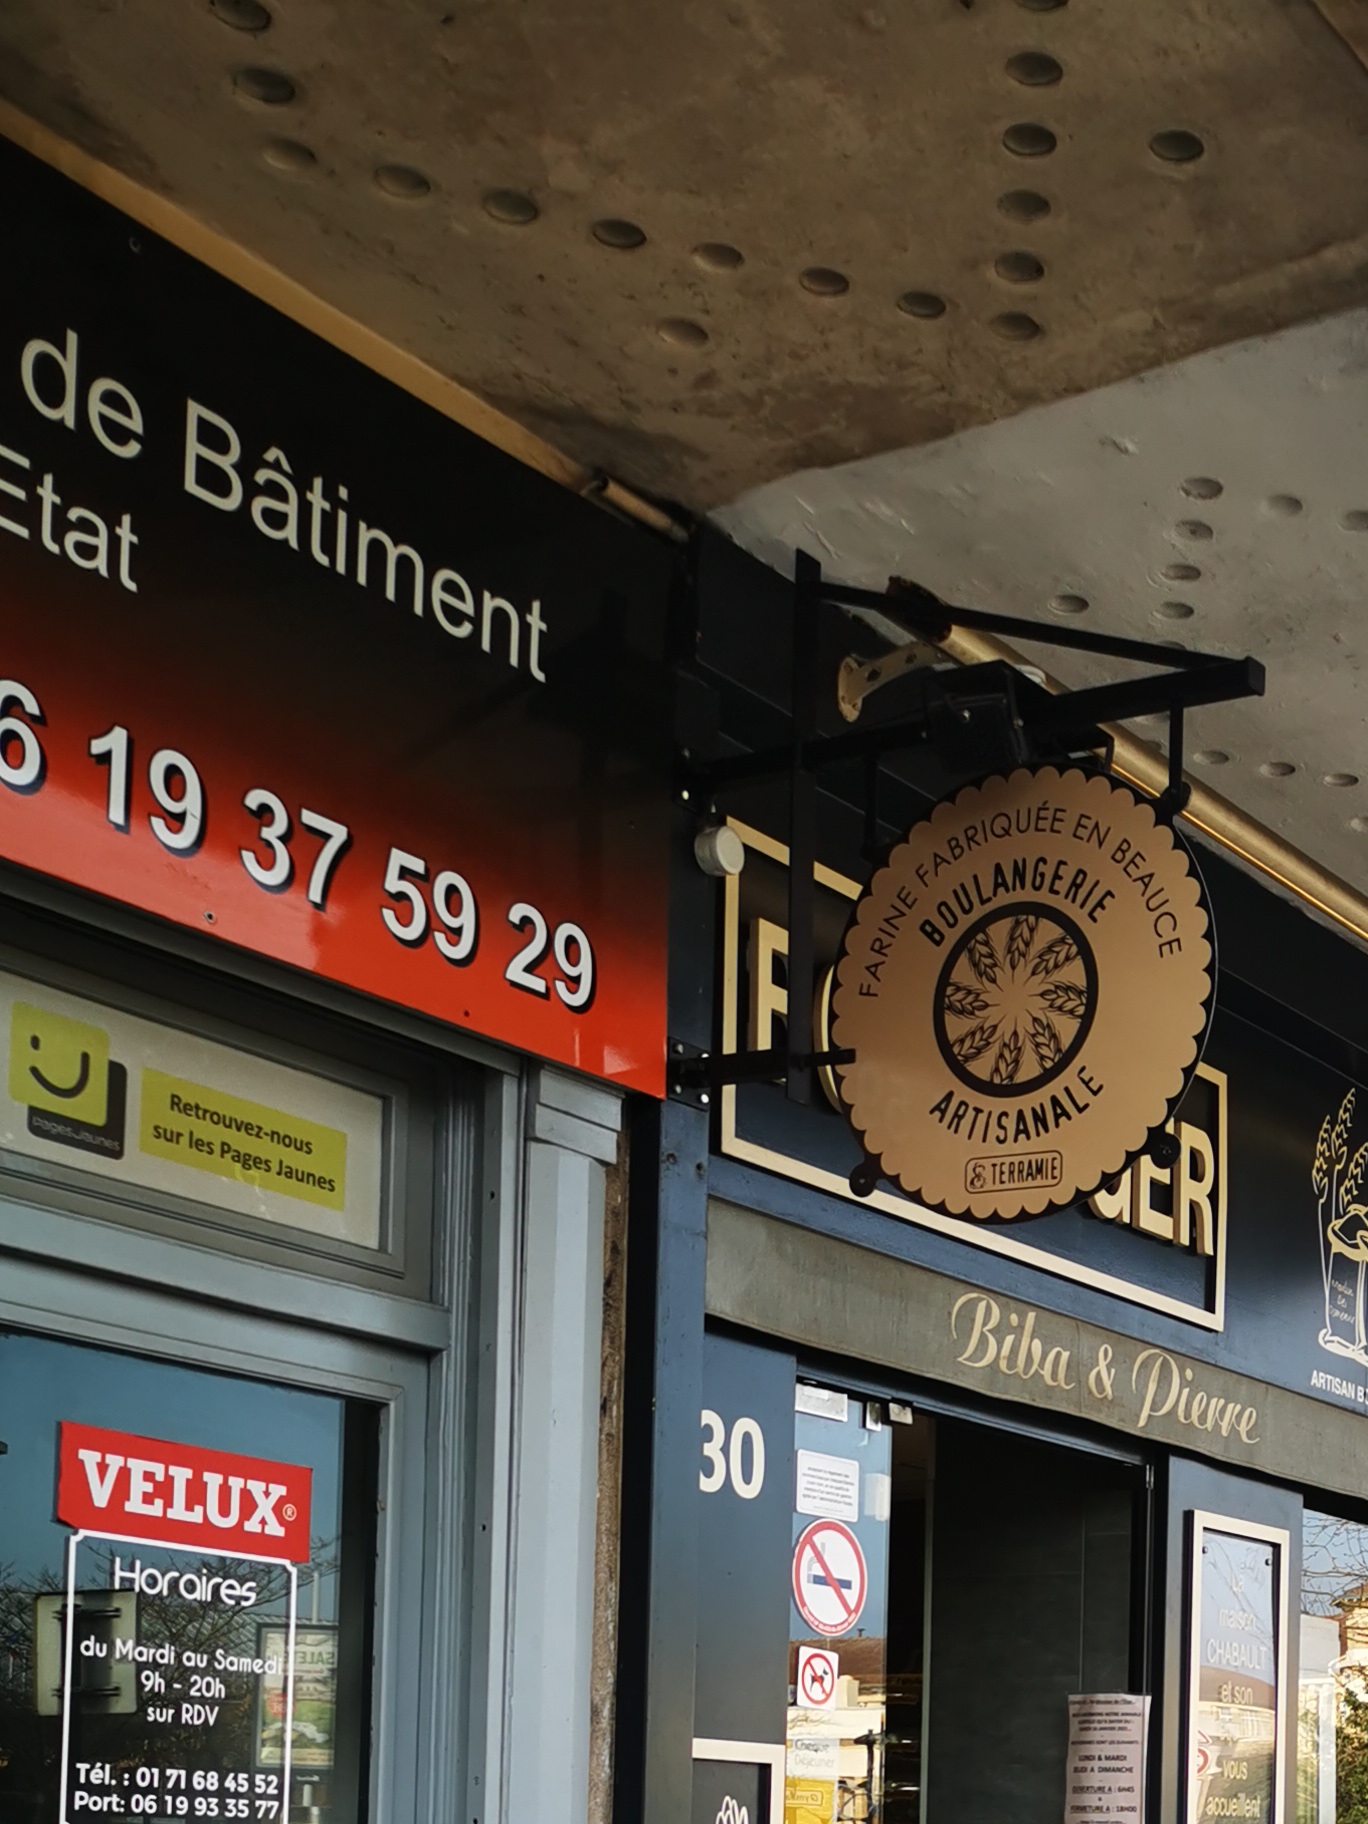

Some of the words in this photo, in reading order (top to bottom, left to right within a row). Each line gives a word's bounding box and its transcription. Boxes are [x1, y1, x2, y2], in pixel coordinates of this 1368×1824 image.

[21, 327, 145, 459] de
[183, 396, 548, 682] Bâtiment
[89, 725, 204, 855] 19
[240, 788, 348, 909] 37
[381, 848, 477, 966] 59
[506, 902, 595, 1011] 29
[859, 885, 919, 998] FARINE
[915, 799, 1068, 890] FABRIQUÉE
[1073, 812, 1112, 850] EN
[1110, 837, 1184, 961] BEAUCE
[918, 856, 1118, 948] BOULANGERIE
[169, 1092, 313, 1155] Retrouvez-nous
[928, 1064, 1105, 1145] ARTISANALE
[152, 1124, 183, 1146] sur
[188, 1127, 214, 1155] les
[220, 1141, 272, 1172] Pages
[276, 1159, 337, 1193] Jaunes
[990, 1154, 1059, 1187] TERRAMIE
[950, 1291, 1076, 1391] Biba
[1087, 1343, 1116, 1401] &
[1131, 1348, 1261, 1445] Pierre
[1310, 1370, 1355, 1399] ARTISAN
[699, 1409, 766, 1501] 30
[77, 1449, 288, 1538] VELUX
[112, 1555, 258, 1607] Horaires
[1220, 1605, 1256, 1631] maison
[80, 1635, 107, 1658] du
[115, 1638, 175, 1666] Mardi
[182, 1651, 207, 1668] au
[214, 1649, 283, 1675] Samedi
[1207, 1639, 1267, 1670] CHABAULT
[141, 1671, 165, 1694] 9h
[189, 1676, 225, 1699] 20h
[1221, 1680, 1232, 1702] et
[1234, 1686, 1253, 1705] son
[146, 1706, 175, 1723] sur
[181, 1704, 219, 1727] RDV
[76, 1762, 116, 1786] Tél.
[136, 1767, 159, 1788] 01
[166, 1769, 186, 1790] 71
[192, 1771, 219, 1791] 68
[224, 1773, 249, 1793] 45
[254, 1775, 279, 1794] 52
[1222, 1760, 1248, 1780] vous
[74, 1792, 125, 1813] Port:
[131, 1794, 158, 1814] 06
[165, 1796, 189, 1815] 19
[194, 1797, 219, 1816] 93
[224, 1799, 249, 1818] 35
[255, 1801, 279, 1820] 77
[1206, 1793, 1261, 1818] accueillent
